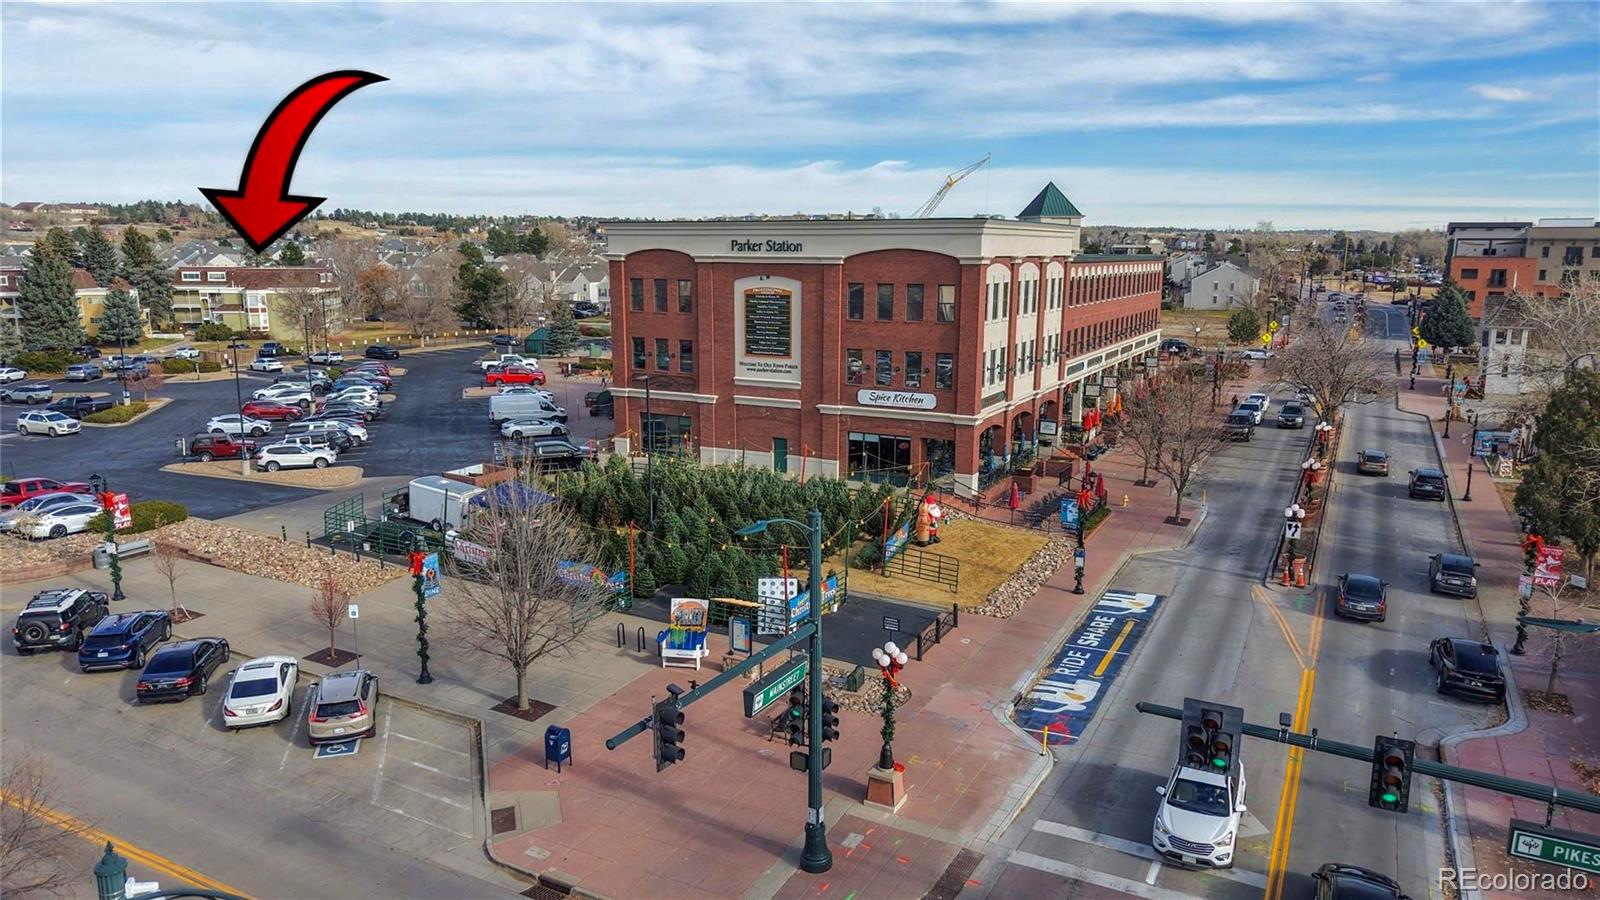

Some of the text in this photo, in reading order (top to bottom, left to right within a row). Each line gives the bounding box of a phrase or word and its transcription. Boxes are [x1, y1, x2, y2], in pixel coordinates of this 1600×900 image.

[731, 239, 803, 253] Parker Station
[869, 391, 924, 404] Spice Kitchen
[115, 521, 131, 529] PLAY
[1534, 577, 1558, 586] PLAY
[424, 586, 440, 597] DINE
[1077, 615, 1116, 647] SHARE
[769, 670, 801, 698] MAINSTREET
[1553, 845, 1600, 867] PIKES
